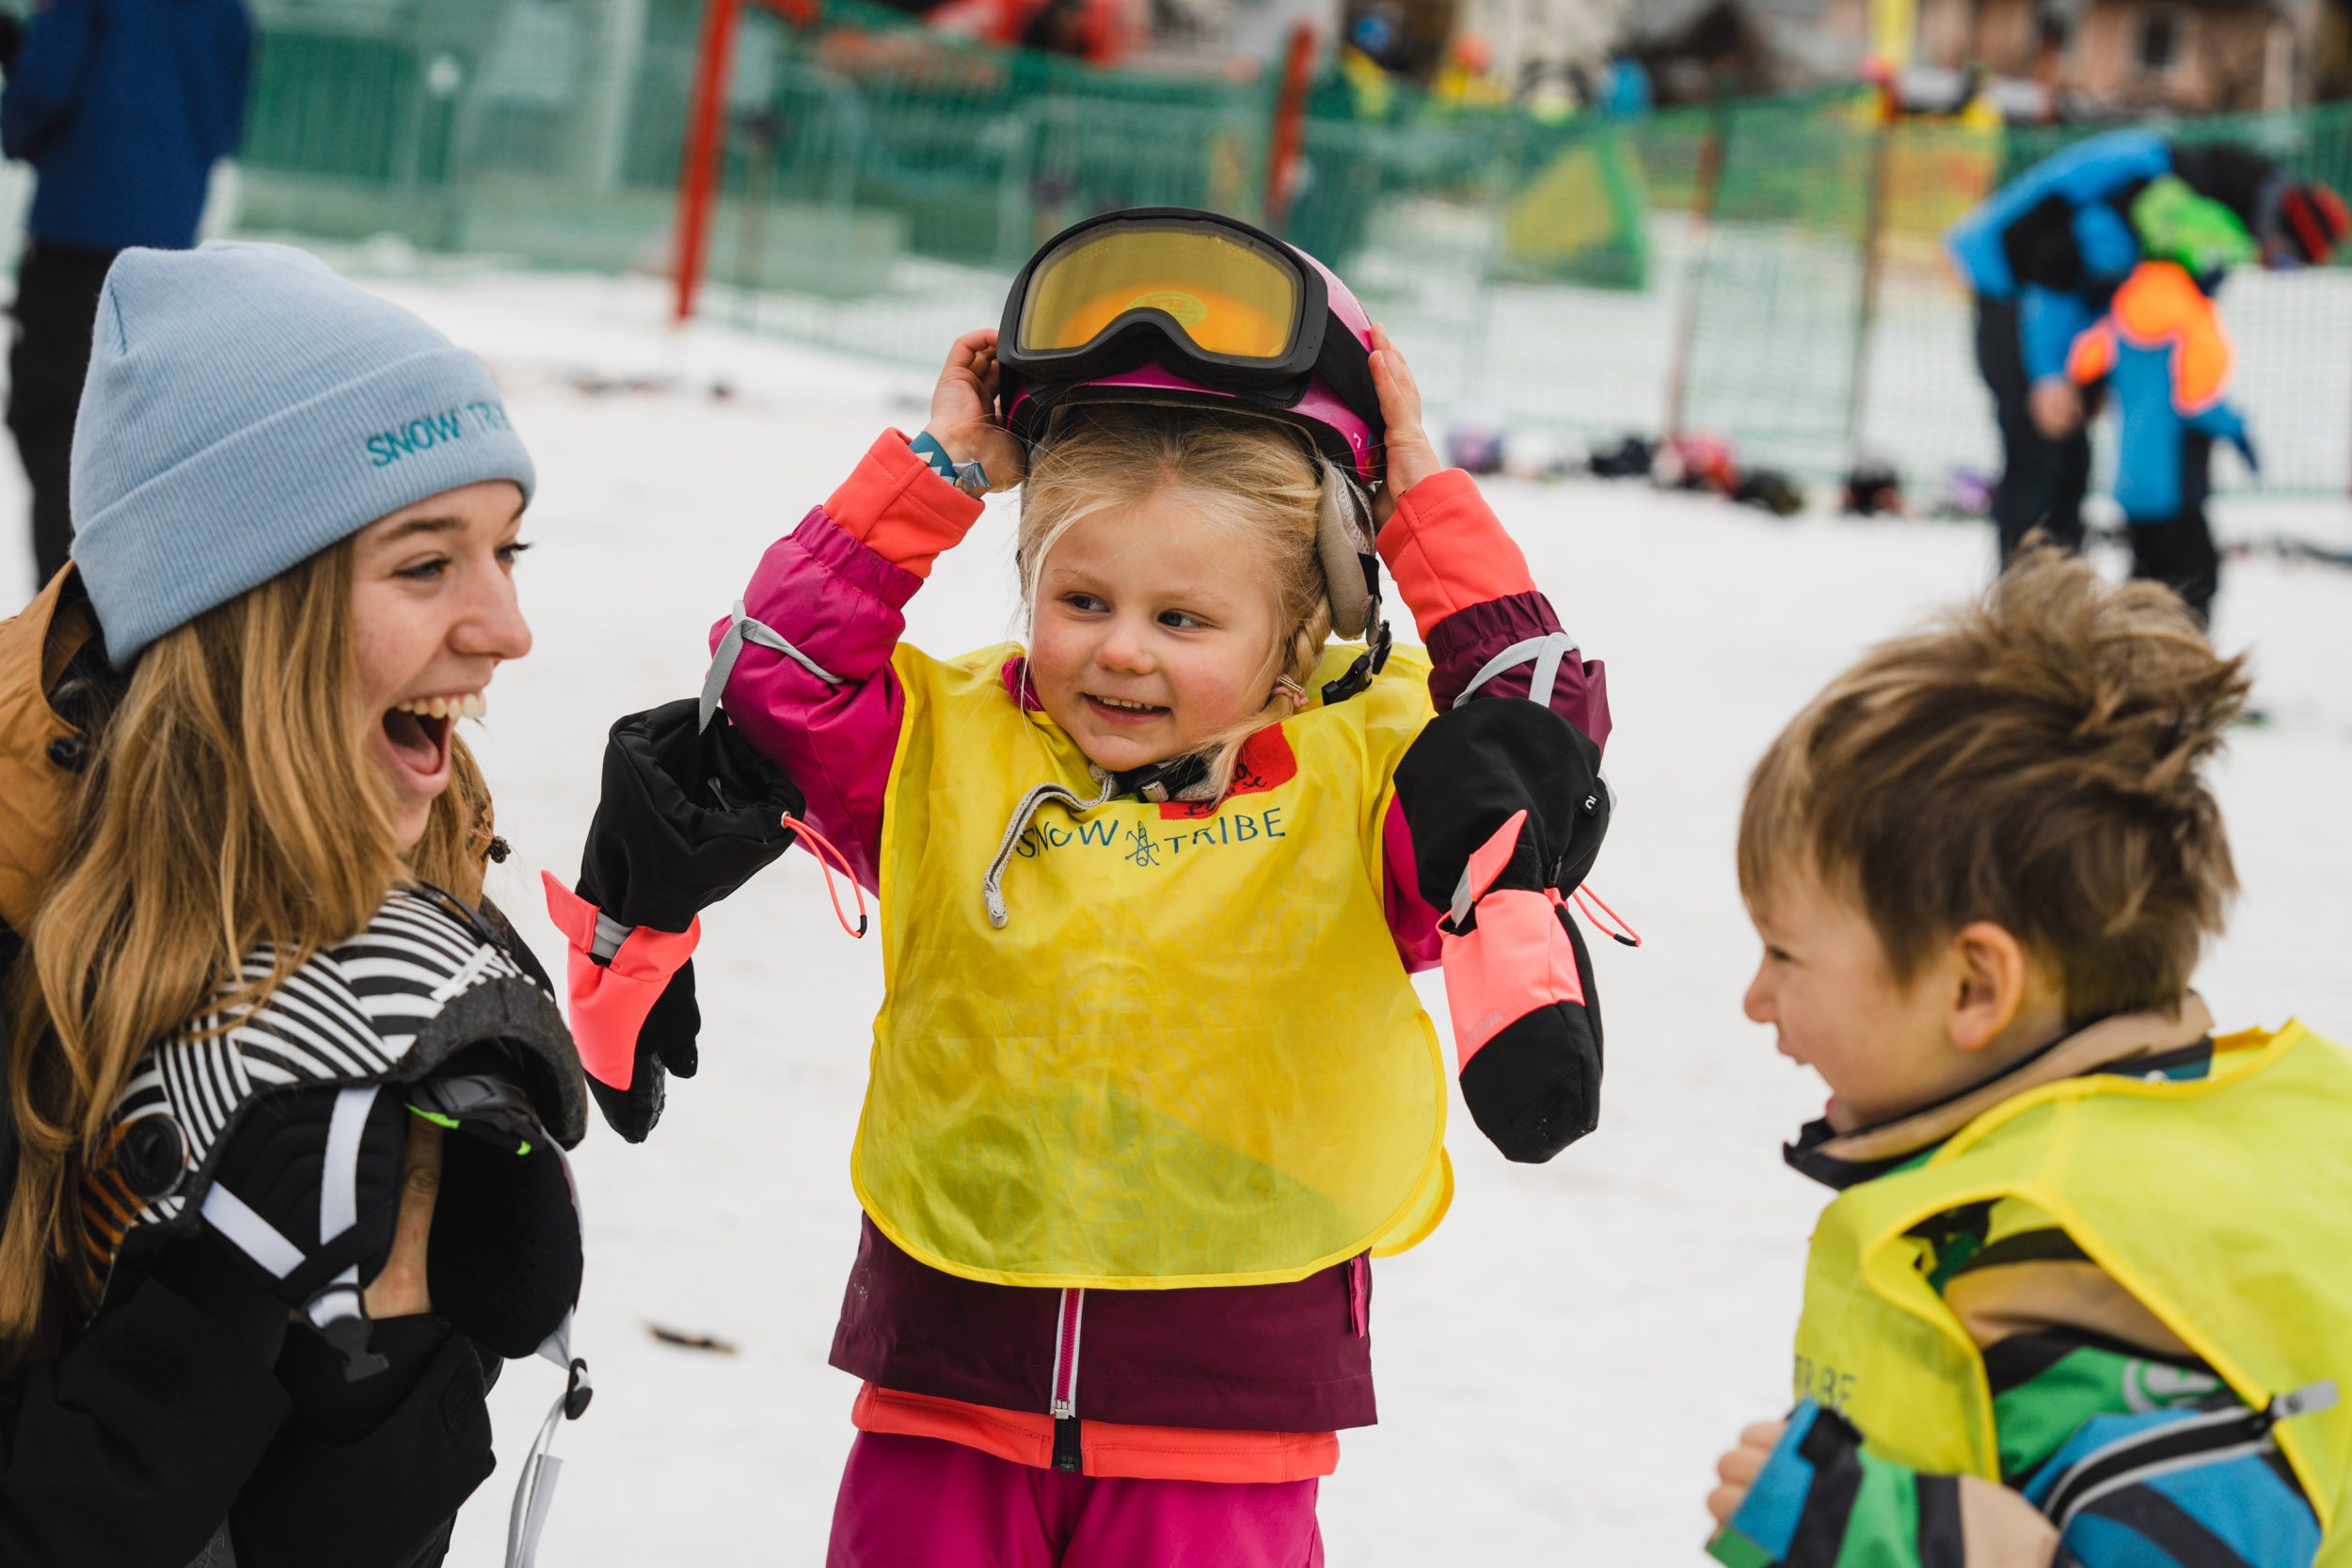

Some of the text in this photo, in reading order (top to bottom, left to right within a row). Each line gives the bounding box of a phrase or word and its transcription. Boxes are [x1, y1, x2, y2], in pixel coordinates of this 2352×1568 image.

[366, 408, 461, 467] SNOW
[1016, 818, 1120, 858] SNOW
[1164, 807, 1286, 854] TRIBE
